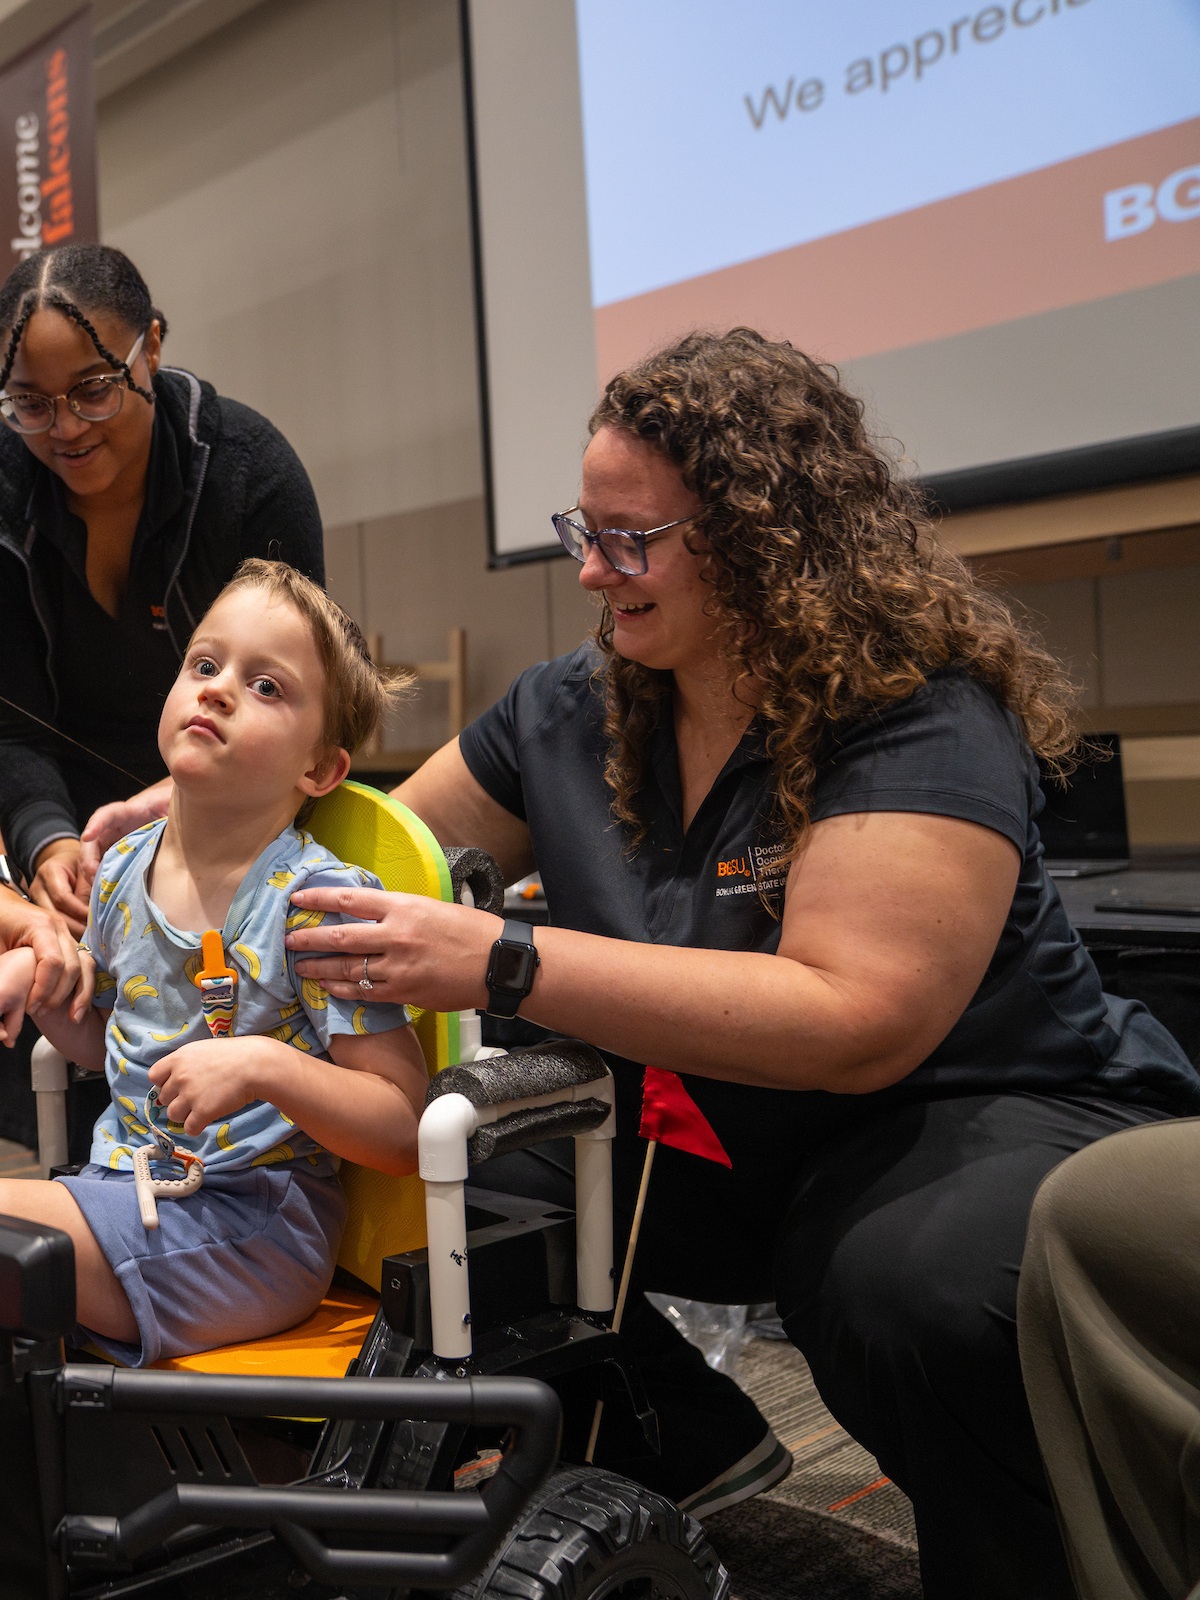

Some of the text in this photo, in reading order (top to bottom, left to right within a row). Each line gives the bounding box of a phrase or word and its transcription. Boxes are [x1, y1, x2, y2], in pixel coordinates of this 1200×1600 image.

[744, 75, 824, 130] We
[11, 111, 42, 263] lcome
[717, 857, 745, 877] BGSU
[734, 883, 757, 895] GREEN
[758, 879, 779, 891] STATE
